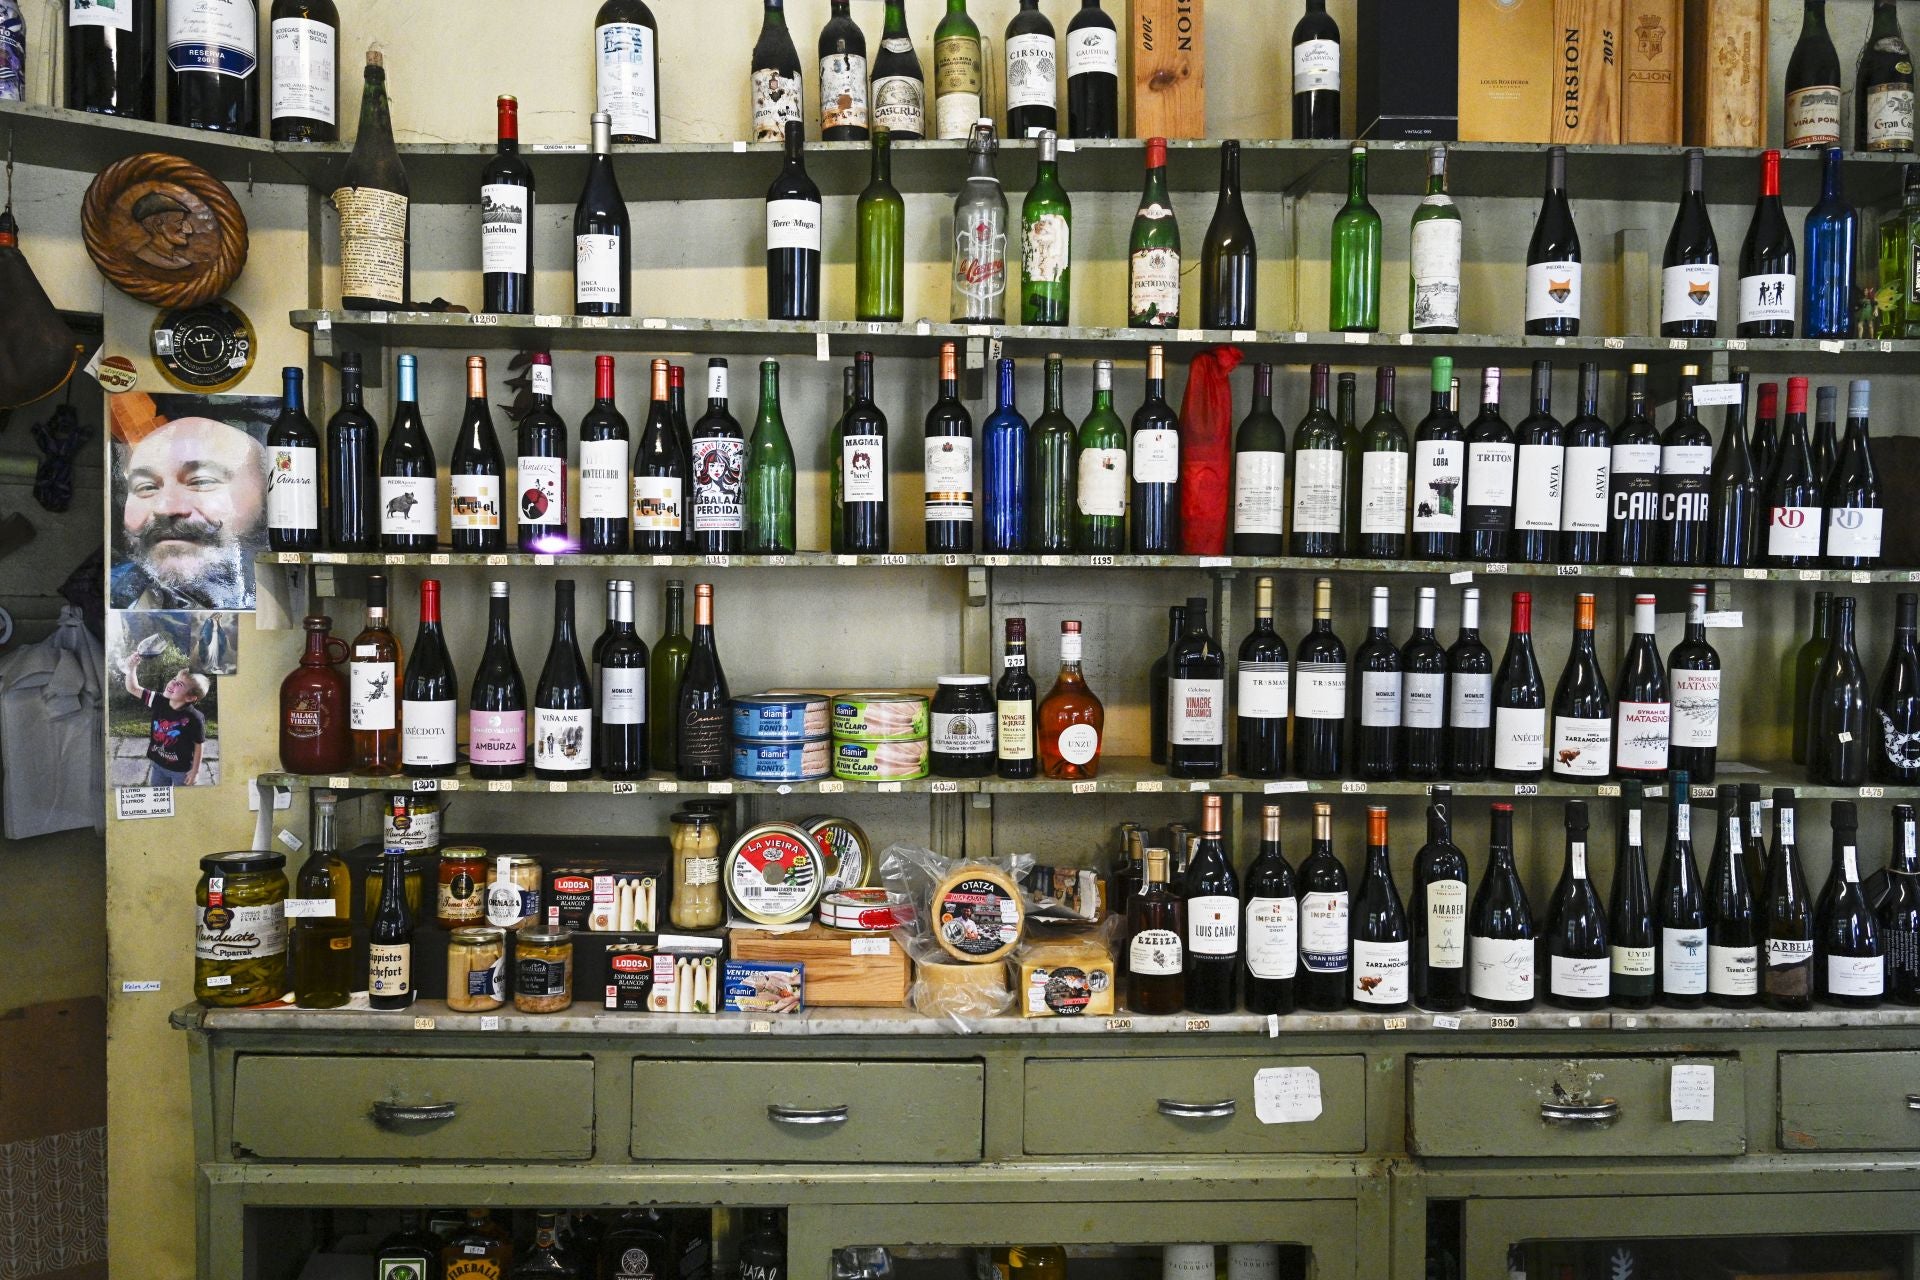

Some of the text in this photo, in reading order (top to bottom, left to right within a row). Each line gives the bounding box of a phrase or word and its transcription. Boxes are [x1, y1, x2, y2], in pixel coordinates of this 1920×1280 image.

[1603, 29, 1614, 66] 2015
[189, 49, 226, 59] RESERVA
[1009, 48, 1054, 60] CIRSION
[1565, 28, 1579, 129] CIRSION
[1628, 71, 1671, 81] ALION
[1793, 118, 1815, 127] VIÑA
[1874, 118, 1898, 130] Gran
[845, 438, 879, 447] MAGMA
[1437, 447, 1445, 455] LA
[1432, 457, 1449, 467] LOBA
[1476, 454, 1512, 462] TRITON
[1549, 464, 1560, 497] SAVIA
[1595, 466, 1606, 499] SAVIA
[704, 495, 731, 505] BALA
[697, 505, 739, 515] PERDIDA
[1613, 491, 1658, 520] CAIR
[1662, 492, 1709, 522] CAIR
[1186, 697, 1212, 708] VINAGRE
[542, 714, 560, 722] VIÑA
[763, 709, 786, 718] diamir
[844, 721, 867, 730] CLARO
[404, 726, 446, 736] ANÉCDOTA
[475, 742, 517, 750] AMBURZA
[761, 749, 783, 758] diamir
[841, 748, 863, 756] diamir
[852, 763, 878, 771] CLARO
[747, 838, 800, 854] LA VIEIRA
[557, 881, 590, 889] LODOSA
[961, 881, 994, 892] OTATZA
[1432, 904, 1464, 914] AMAREN
[1195, 924, 1212, 937] LUIS
[220, 948, 252, 957] Piparrak
[615, 958, 648, 968] LODOSA
[729, 987, 752, 995] diamir
[448, 1262, 498, 1280] FIREBALL
